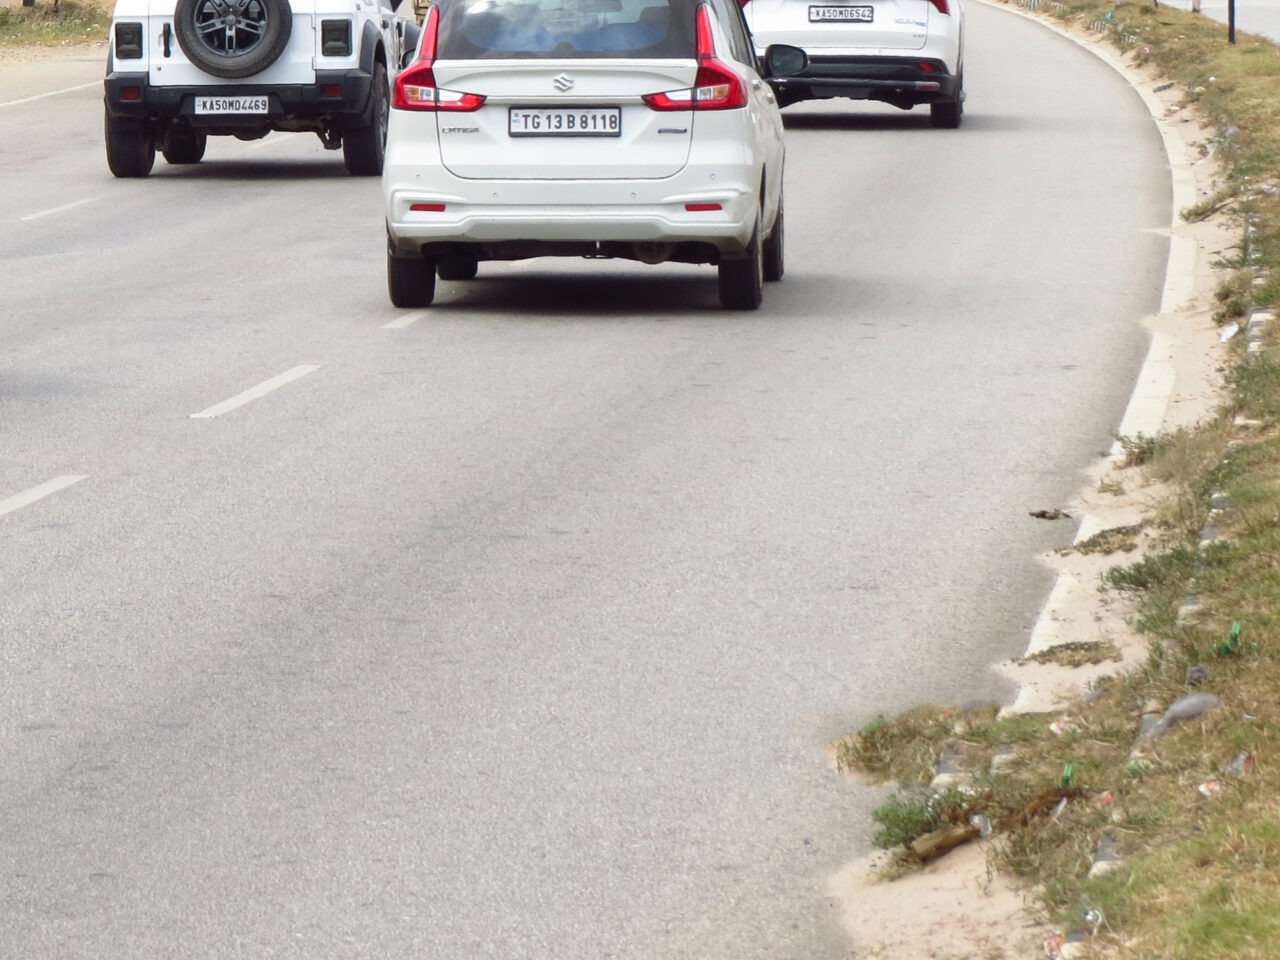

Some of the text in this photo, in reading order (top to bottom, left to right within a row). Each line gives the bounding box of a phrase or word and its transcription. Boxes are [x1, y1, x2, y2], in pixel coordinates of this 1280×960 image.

[202, 99, 267, 111] KA50MD4469
[522, 114, 618, 129] TG 13 B 8118
